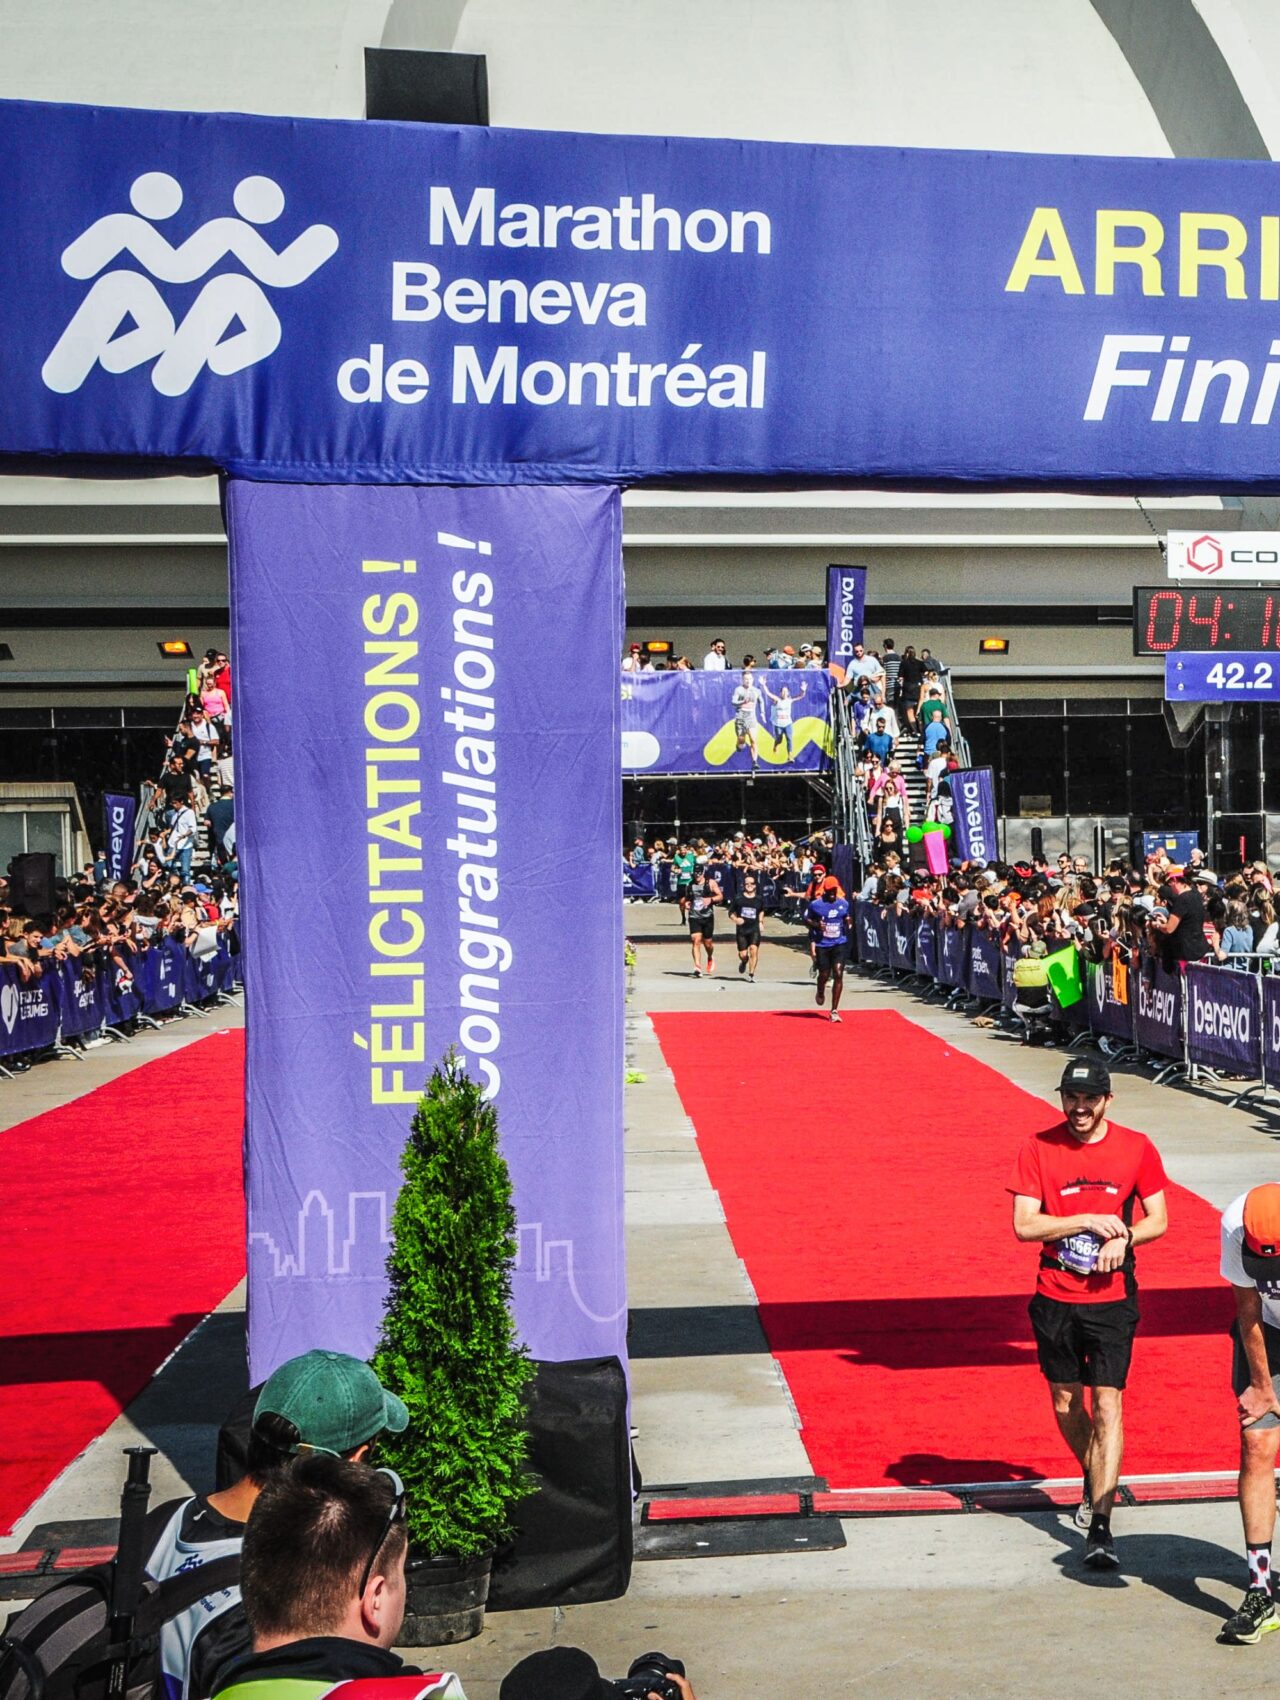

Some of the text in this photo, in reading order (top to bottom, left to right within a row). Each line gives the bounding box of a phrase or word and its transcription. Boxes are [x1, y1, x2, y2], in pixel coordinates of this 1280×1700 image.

[429, 186, 771, 254] Marathon
[391, 261, 646, 326] Beneva
[337, 342, 767, 409] de Montréal
[835, 577, 855, 657] beneva
[1206, 662, 1273, 690] 42.2
[1194, 990, 1250, 1043] beneva
[1062, 1238, 1100, 1257] 10662
